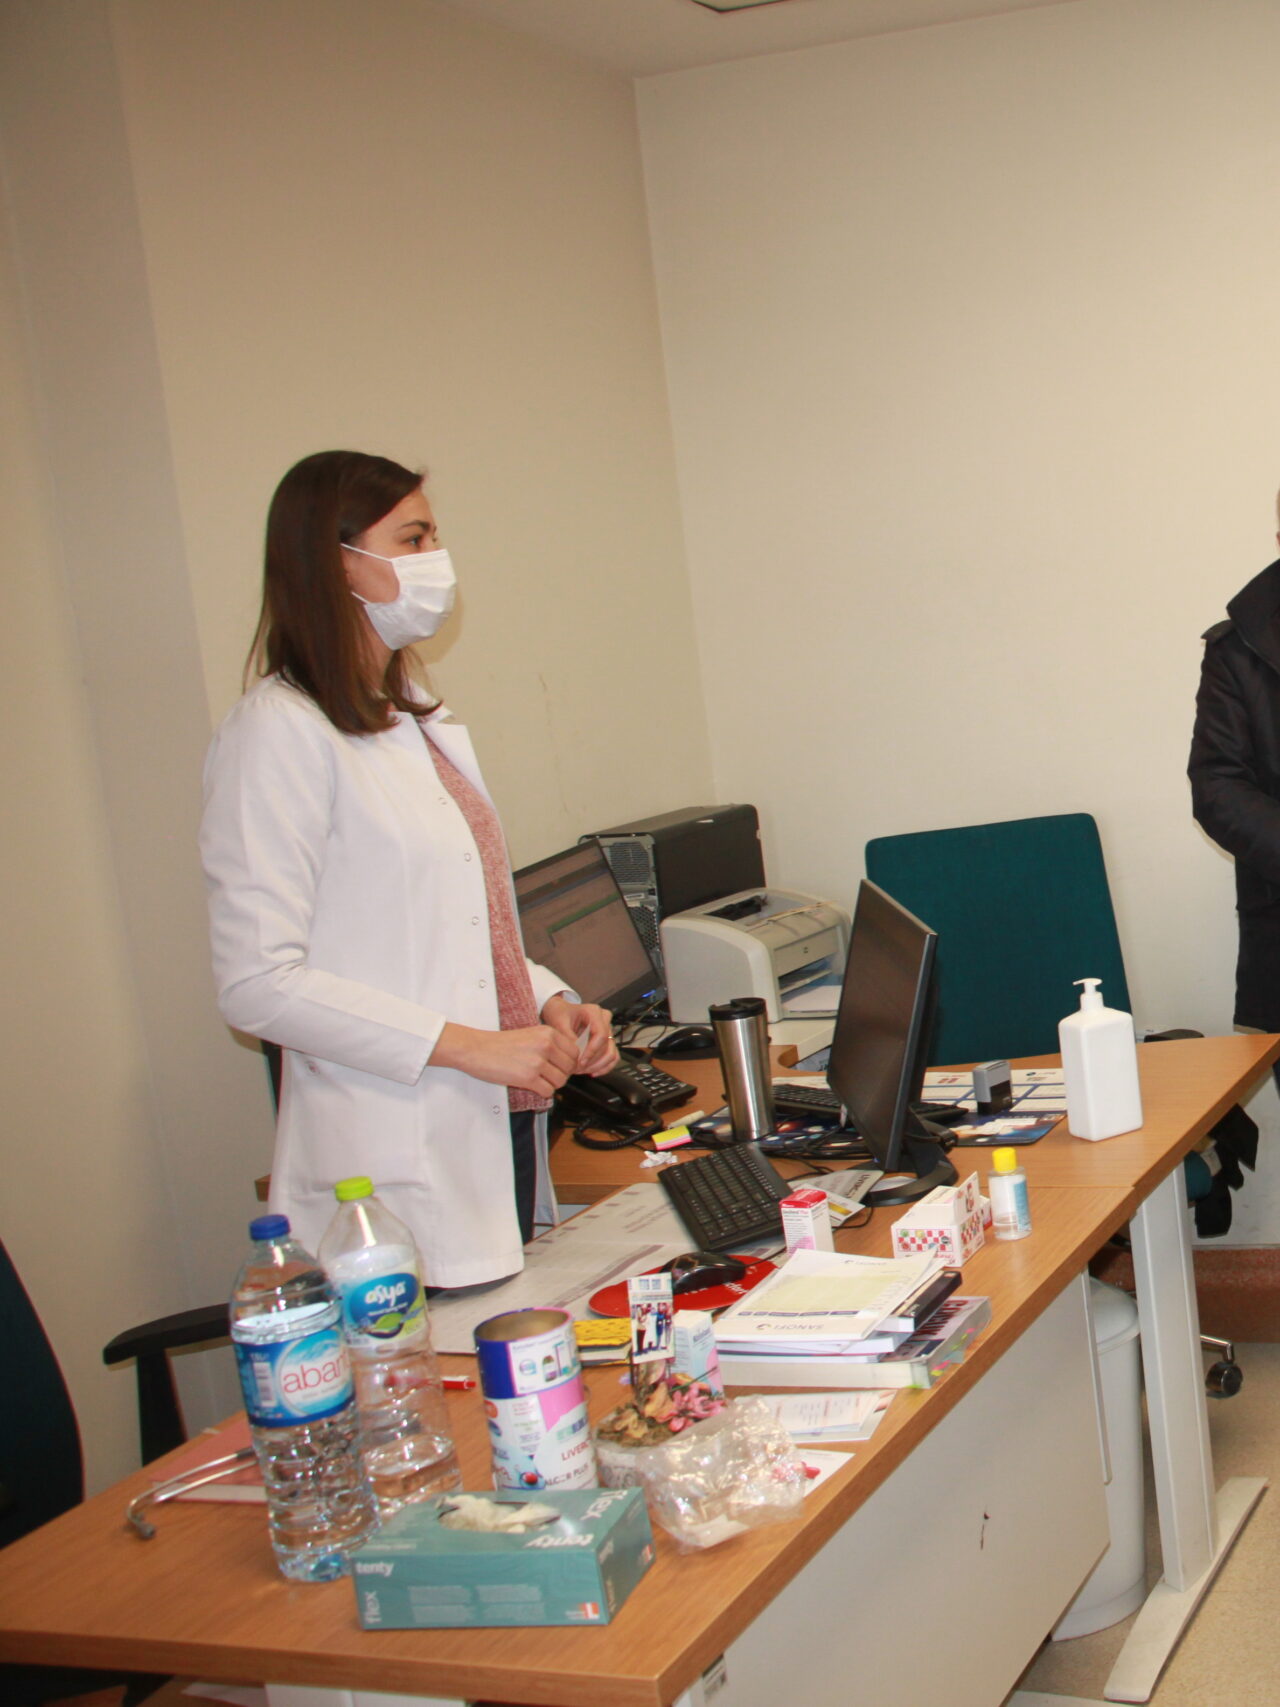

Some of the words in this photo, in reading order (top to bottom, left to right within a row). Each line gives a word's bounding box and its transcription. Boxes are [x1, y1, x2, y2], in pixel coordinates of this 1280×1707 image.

[364, 1281, 406, 1308] asya
[525, 1533, 594, 1548] tenty
[355, 1561, 395, 1577] tenty
